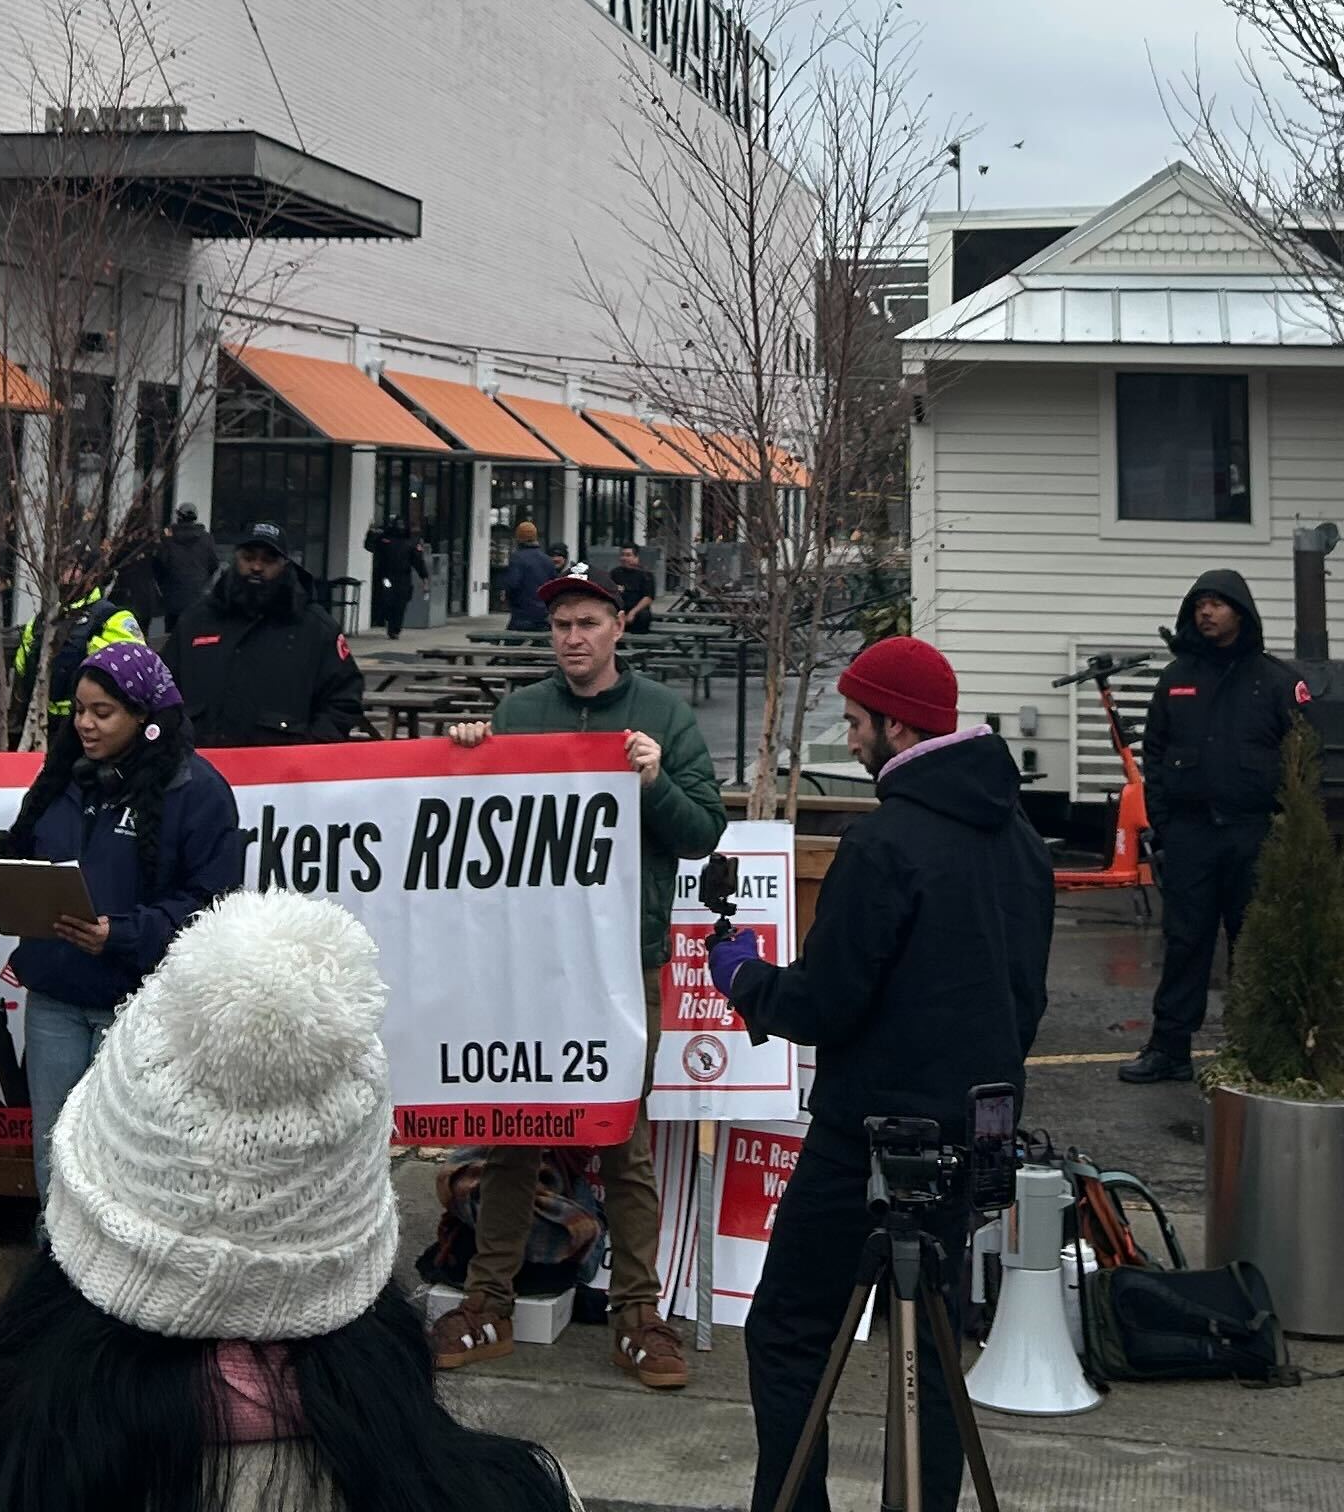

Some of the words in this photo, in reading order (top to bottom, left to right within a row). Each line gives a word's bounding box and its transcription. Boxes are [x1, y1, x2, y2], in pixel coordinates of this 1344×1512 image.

[240, 804, 382, 894] rkers
[402, 791, 620, 891] RISING
[671, 961, 715, 987] Work
[677, 991, 735, 1026] Rising
[440, 1040, 554, 1084] LOCAL
[561, 1039, 609, 1083] 25
[403, 1108, 460, 1139] Never
[463, 1108, 486, 1139] be
[734, 1137, 766, 1167] D.C.
[905, 1349, 916, 1415] DYNEX
